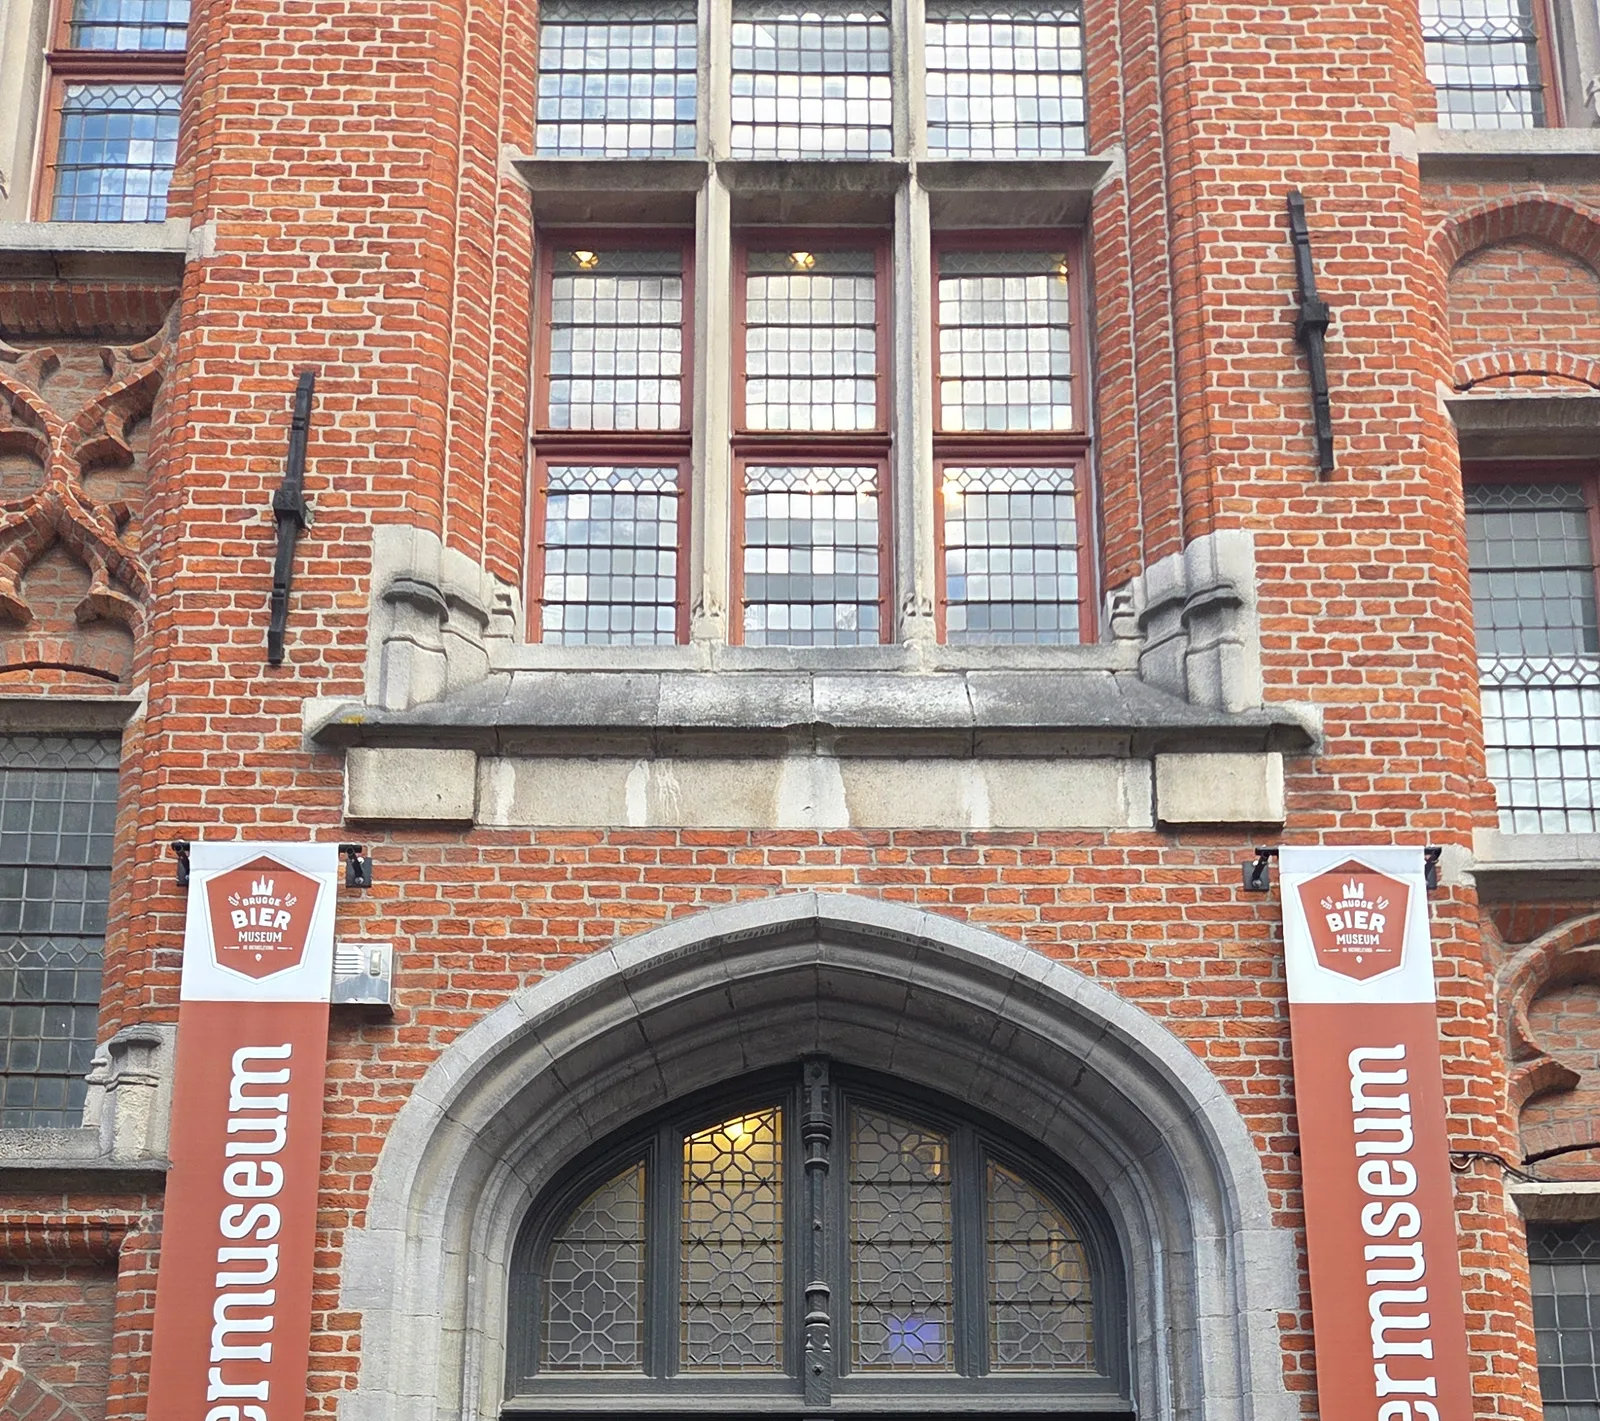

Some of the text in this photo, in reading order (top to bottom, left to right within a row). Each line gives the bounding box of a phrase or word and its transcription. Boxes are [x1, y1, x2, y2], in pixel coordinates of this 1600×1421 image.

[242, 896, 281, 907] BRUGGE
[1335, 900, 1374, 910] BRUGGE
[230, 907, 291, 931] BIER
[1325, 910, 1386, 934] BIER
[238, 931, 282, 942] MUSEUM
[1336, 934, 1380, 945] MUSEUM
